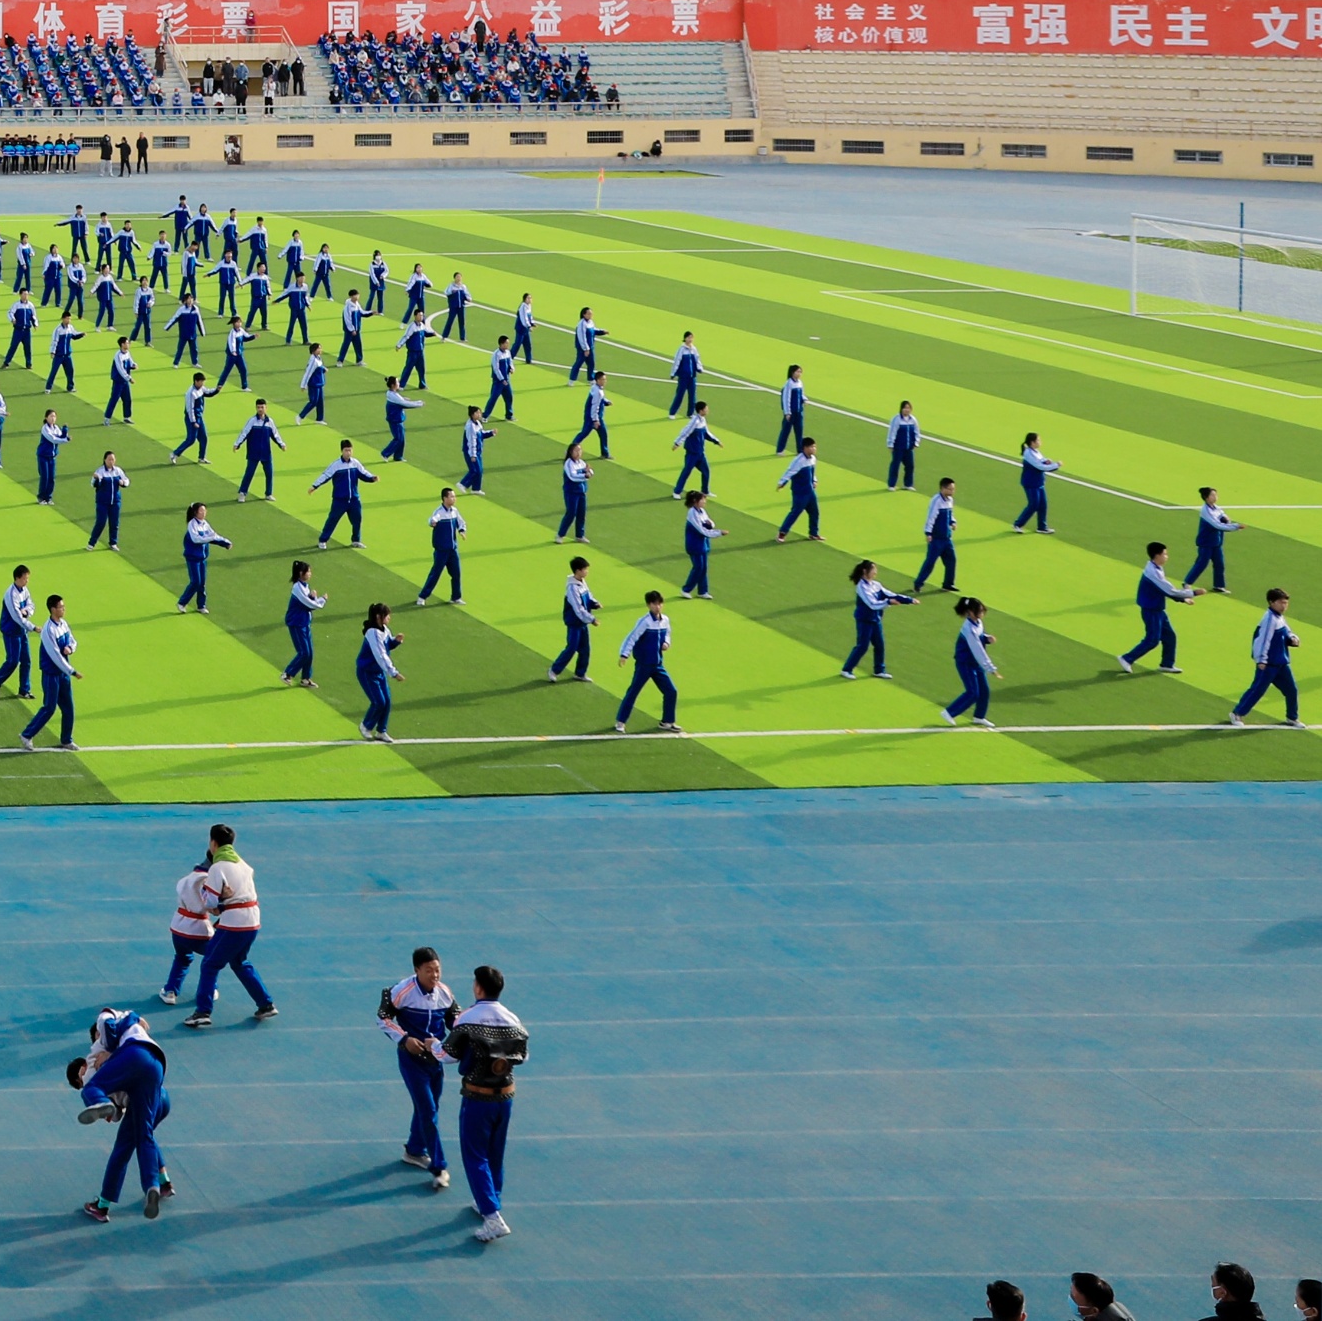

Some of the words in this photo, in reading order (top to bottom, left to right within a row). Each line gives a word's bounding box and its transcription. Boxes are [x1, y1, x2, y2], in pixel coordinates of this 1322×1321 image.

[814, 3, 927, 21] 社会主义
[972, 3, 1069, 46] 富强
[1109, 4, 1209, 47] 民主
[814, 26, 928, 44] 核心价值观
